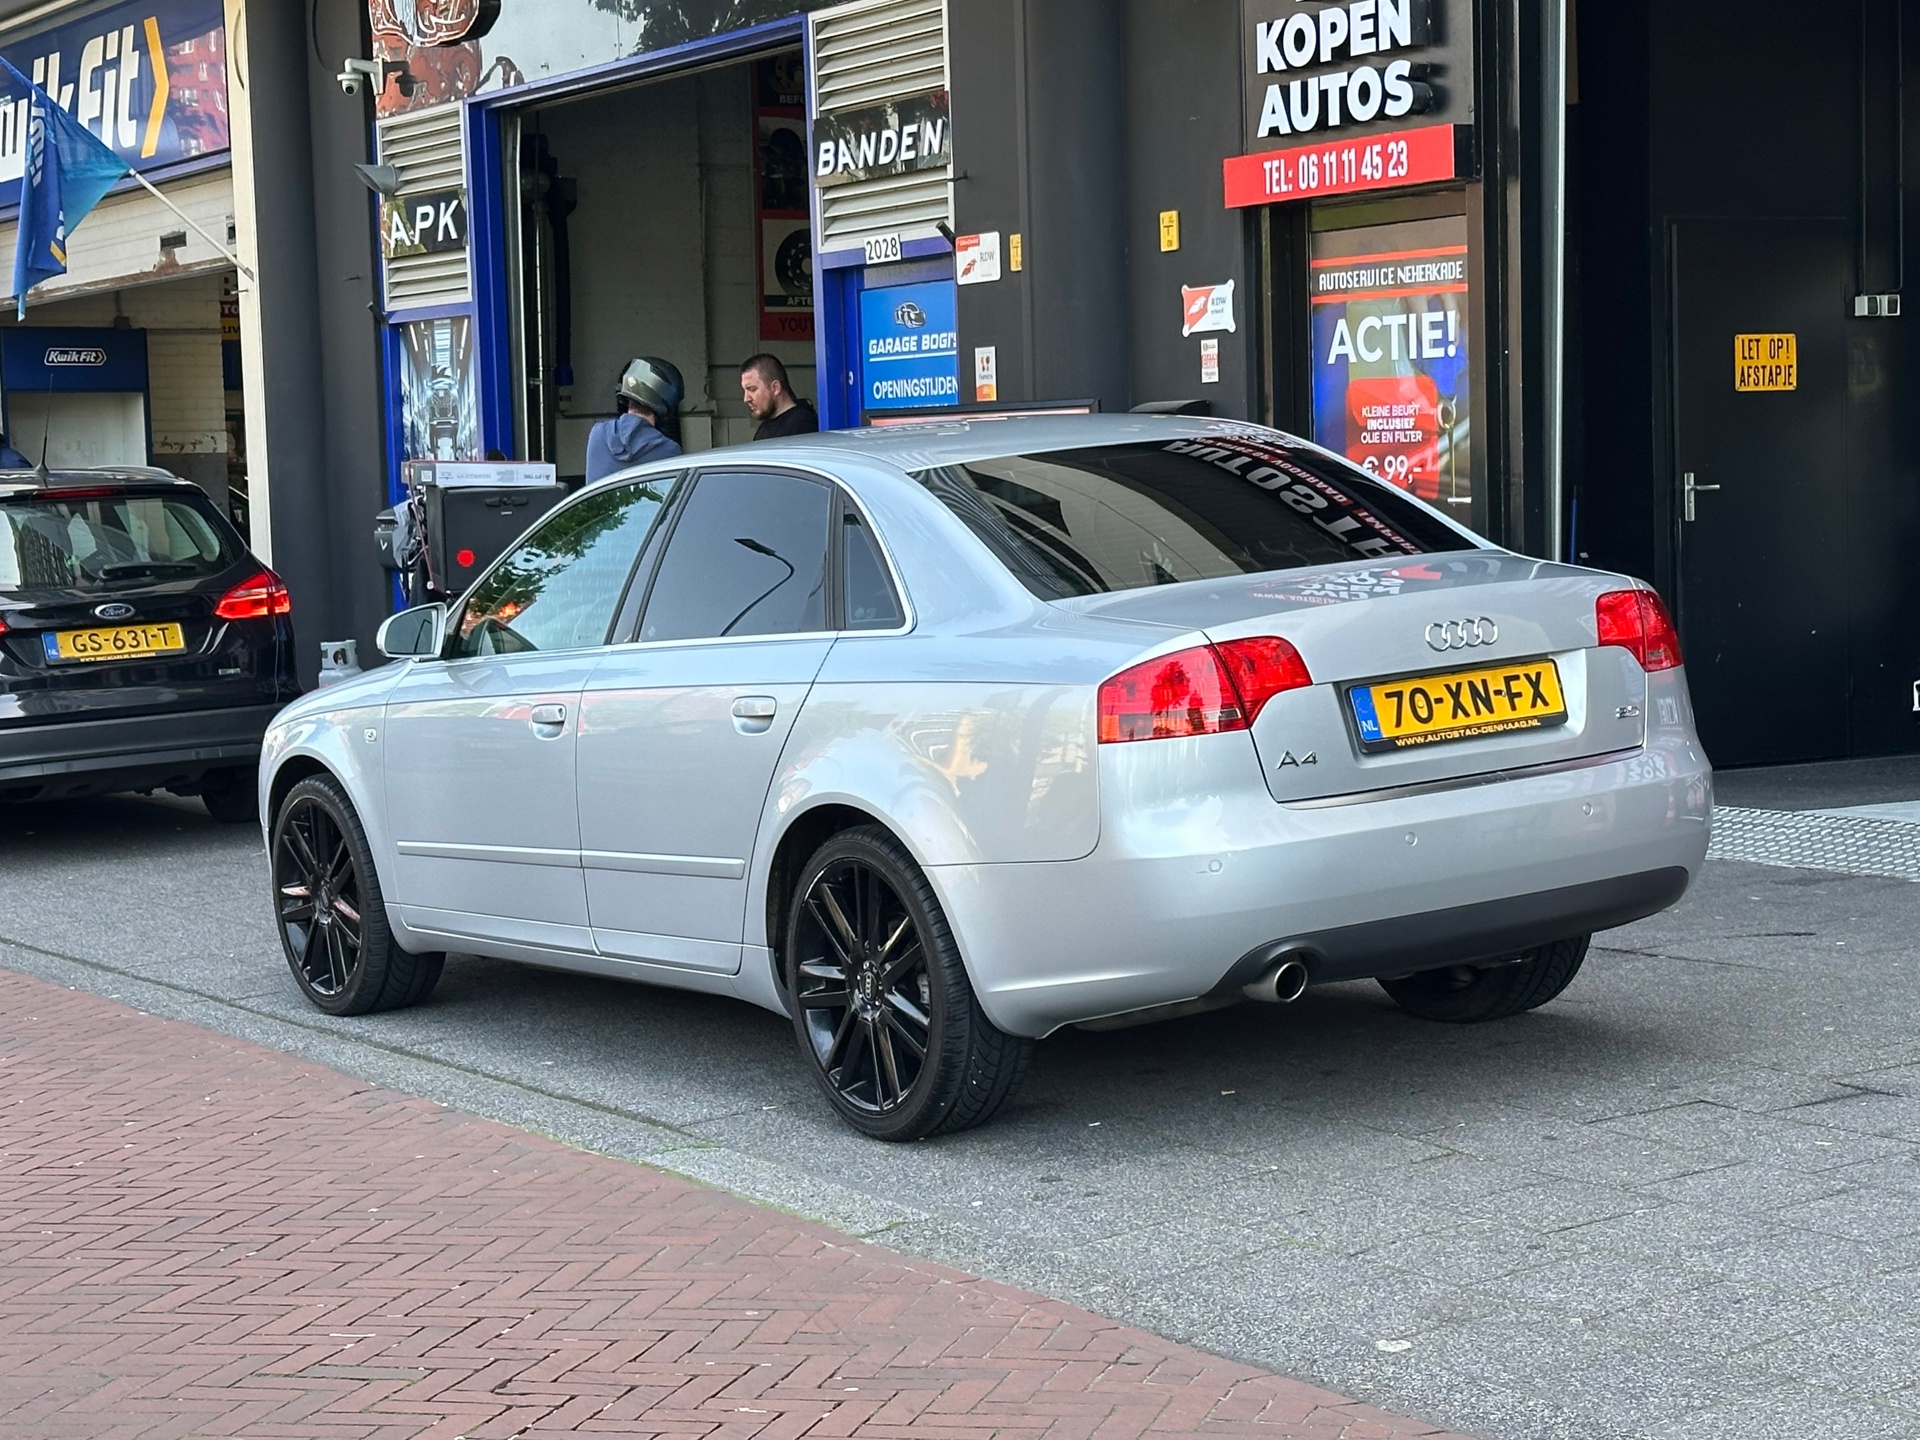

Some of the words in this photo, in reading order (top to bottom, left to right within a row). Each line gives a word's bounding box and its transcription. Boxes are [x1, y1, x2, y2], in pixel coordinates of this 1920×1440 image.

[1256, 0, 1411, 74] KOPEN
[1257, 60, 1414, 138] AUTOS
[817, 119, 943, 176] BANDEN
[1263, 159, 1293, 194] TEL:
[1299, 153, 1318, 190] 06
[1323, 151, 1337, 186] 11
[1342, 148, 1356, 183] 11
[1361, 144, 1382, 181] 45
[1387, 140, 1408, 178] 23
[390, 199, 459, 249] APK
[866, 237, 899, 261] 2028
[980, 251, 994, 262] RDW
[1319, 267, 1395, 291] AUTOSERVICE
[1397, 261, 1463, 284] NEHERKADE
[868, 335, 918, 355] GARAGE
[1327, 310, 1457, 365] ACTIE!
[1741, 338, 1761, 360] LET
[1769, 338, 1790, 360] OP!
[873, 376, 958, 399] OPENINGSTIJDEN
[1739, 365, 1794, 387] AFSTAPJE
[1361, 405, 1390, 417] KLEINE
[1392, 403, 1420, 416] BEURT
[1367, 417, 1415, 430] INCLUSIEF
[1361, 431, 1380, 444] OLIE
[1381, 431, 1393, 443] EN
[1395, 430, 1422, 443] FILTER
[71, 627, 171, 653] GS-631-T
[1384, 671, 1550, 729] 70-XN-FX
[1363, 720, 1379, 733] NL
[1277, 750, 1318, 769] A4
